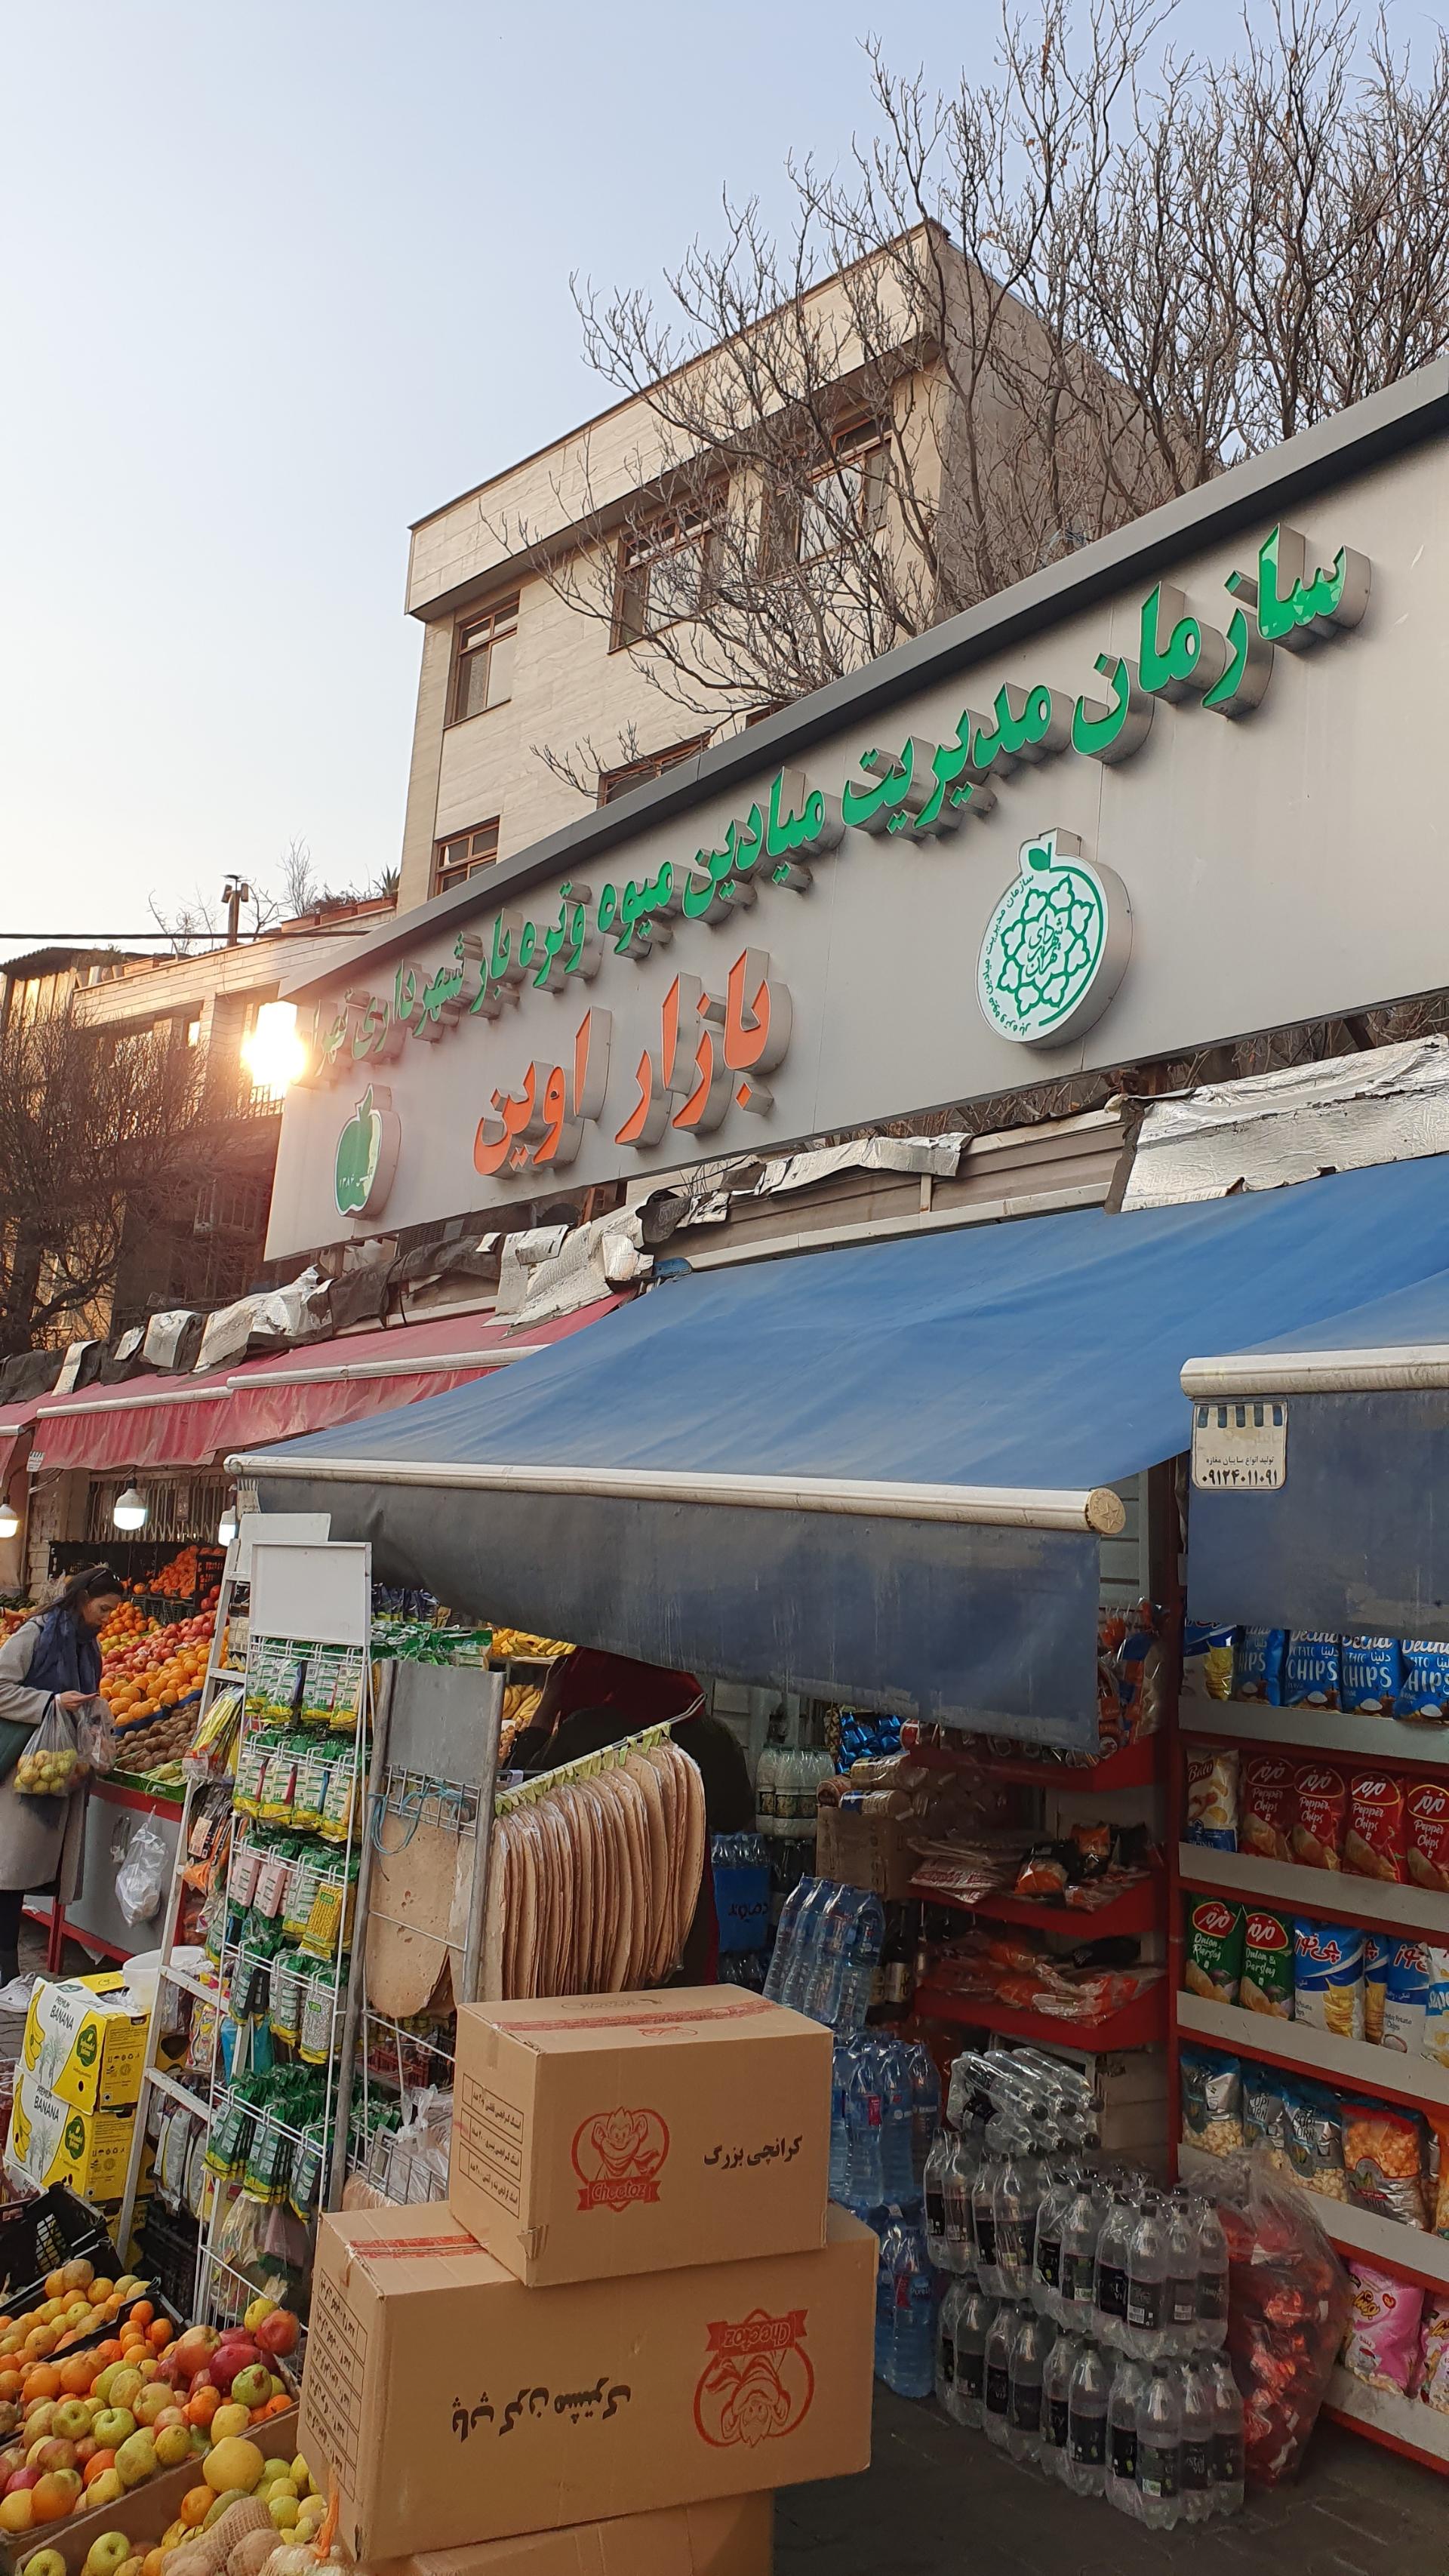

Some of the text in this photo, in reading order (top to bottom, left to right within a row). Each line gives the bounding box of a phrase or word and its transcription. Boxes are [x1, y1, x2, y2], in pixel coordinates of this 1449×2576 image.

[1070, 522, 1349, 756] سازمان
[840, 681, 1052, 833] مدیریت
[681, 765, 826, 919] میادین
[1006, 874, 1035, 909] سازمان
[596, 861, 674, 955] میوه
[986, 908, 1006, 956] مدیریت
[982, 958, 994, 995] میادین
[988, 996, 1001, 1018] میوه
[472, 946, 771, 1176] بازار اوین
[1206, 1455, 1222, 1466] مغازه
[1244, 1455, 1259, 1466] انواع
[1260, 1455, 1275, 1466] تولید
[1371, 1651, 1392, 1665] دلینا
[1287, 1659, 1337, 1682] CHIPS
[1343, 1665, 1392, 1688] CHIPS
[1299, 1796, 1330, 1810] Pepper
[1352, 1802, 1384, 1817] Pepper
[1414, 1819, 1444, 1835] Pepper
[1245, 1947, 1267, 1961] Onion
[1244, 1959, 1276, 1977] Parsley
[55, 1995, 71, 2009] PREMIUM
[50, 2005, 75, 2031] BANANA
[34, 2095, 60, 2122] BANANA
[703, 2134, 803, 2171] کرانچی بزرگ
[592, 2180, 647, 2201] Cheetoz
[723, 2321, 791, 2350] Cheetoz
[452, 2377, 632, 2443] پاپ کرن مشترک
